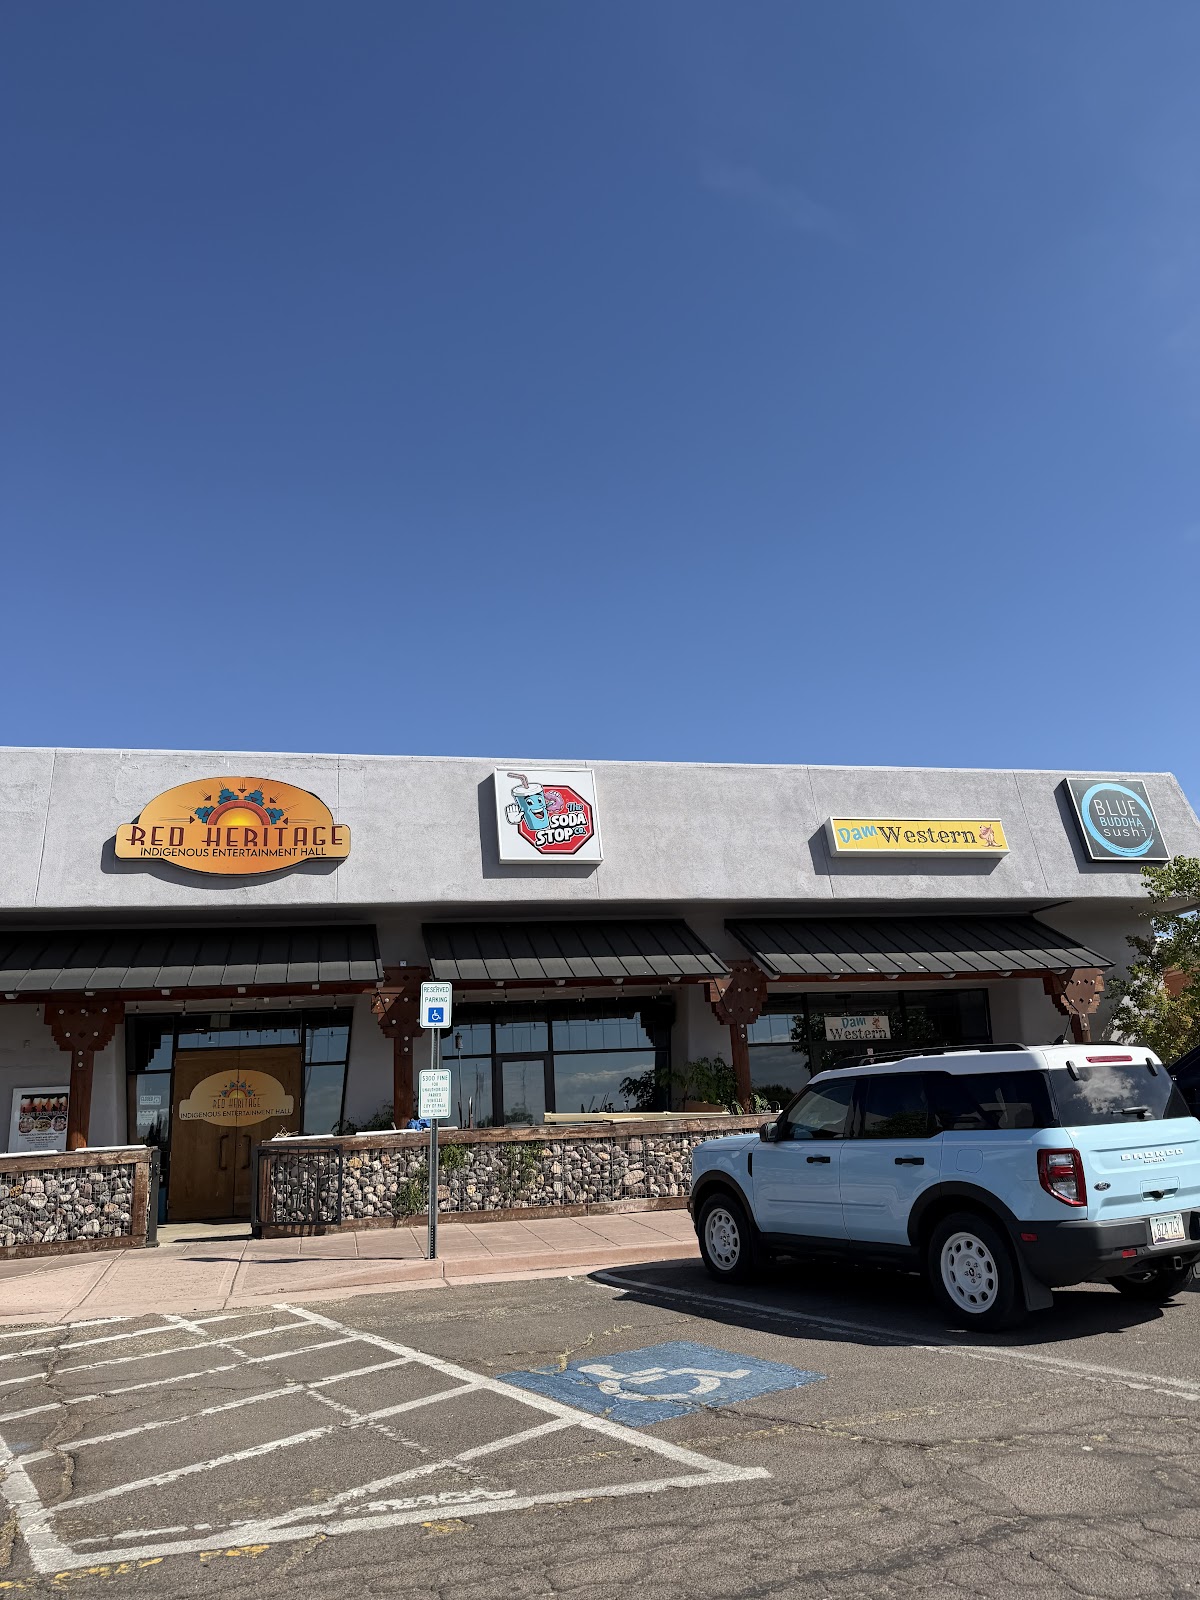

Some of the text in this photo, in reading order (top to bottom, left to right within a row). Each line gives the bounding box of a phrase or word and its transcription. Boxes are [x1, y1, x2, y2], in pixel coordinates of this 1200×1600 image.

[566, 802, 584, 812] The
[1093, 799, 1140, 817] BLUE
[550, 813, 587, 829] SODA
[1099, 817, 1144, 828] BUDDHA
[126, 825, 343, 847] RED HERITAGE
[535, 828, 574, 847] STOP
[837, 824, 978, 844] Dam Western
[1103, 827, 1148, 837] sushi
[140, 846, 327, 858] INDIGENOUS ENTERTAINMENT HALL
[841, 1017, 867, 1029] Dam
[829, 1028, 888, 1040] Western
[212, 1097, 261, 1109] RED HERITAGE
[180, 1107, 292, 1119] INDIGENOUS ENTERTAINMENT HALL
[1120, 1148, 1184, 1161] BRONCO
